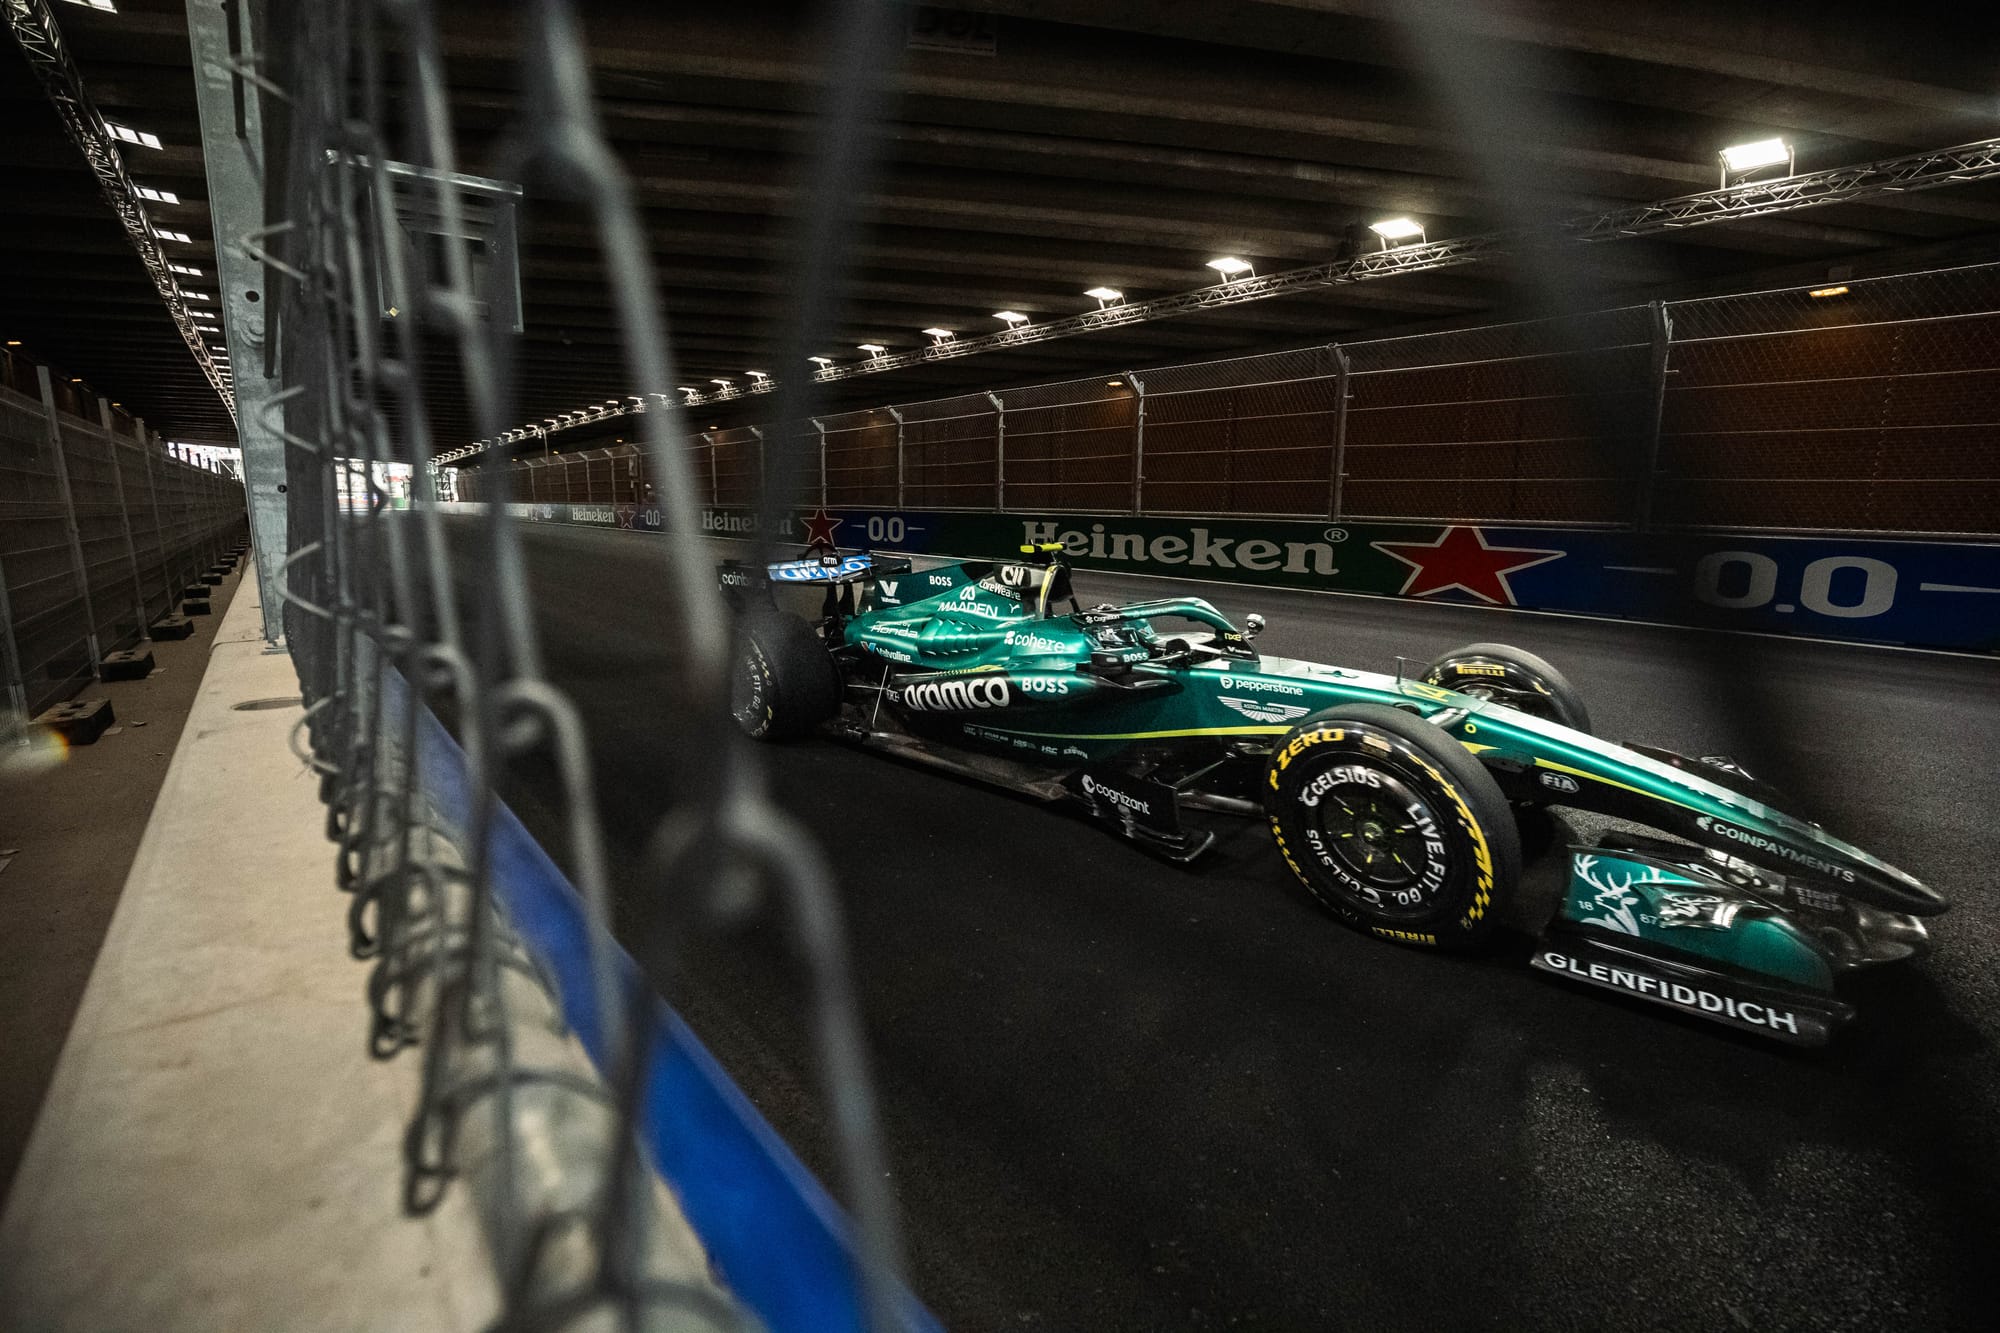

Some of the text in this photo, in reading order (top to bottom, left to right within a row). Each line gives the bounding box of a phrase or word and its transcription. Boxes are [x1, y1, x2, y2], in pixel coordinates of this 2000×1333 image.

[572, 507, 616, 523] Heineken
[867, 516, 905, 543] 0.0
[822, 555, 838, 565] arm
[929, 575, 952, 587] BOSS
[979, 578, 1021, 601] CoreWeave
[1696, 551, 1898, 618] 0.0
[870, 625, 919, 639] Honda
[1014, 631, 1066, 654] cohere
[1123, 652, 1149, 663] BOSS
[904, 677, 1010, 711] aramco
[1022, 677, 1069, 694] BOSS
[1236, 680, 1304, 696] pepperstone
[1276, 728, 1345, 770] ZERO
[1311, 766, 1382, 796] CELSIUS
[1543, 774, 1576, 791] FIA
[1095, 783, 1151, 815] cognizant
[1306, 829, 1361, 892] CELSIUS
[1713, 823, 1856, 883] COINPAYMENTS
[1577, 899, 1594, 911] 18
[1639, 913, 1658, 926] 87
[1543, 951, 1799, 1035] GLENFIDDICH
